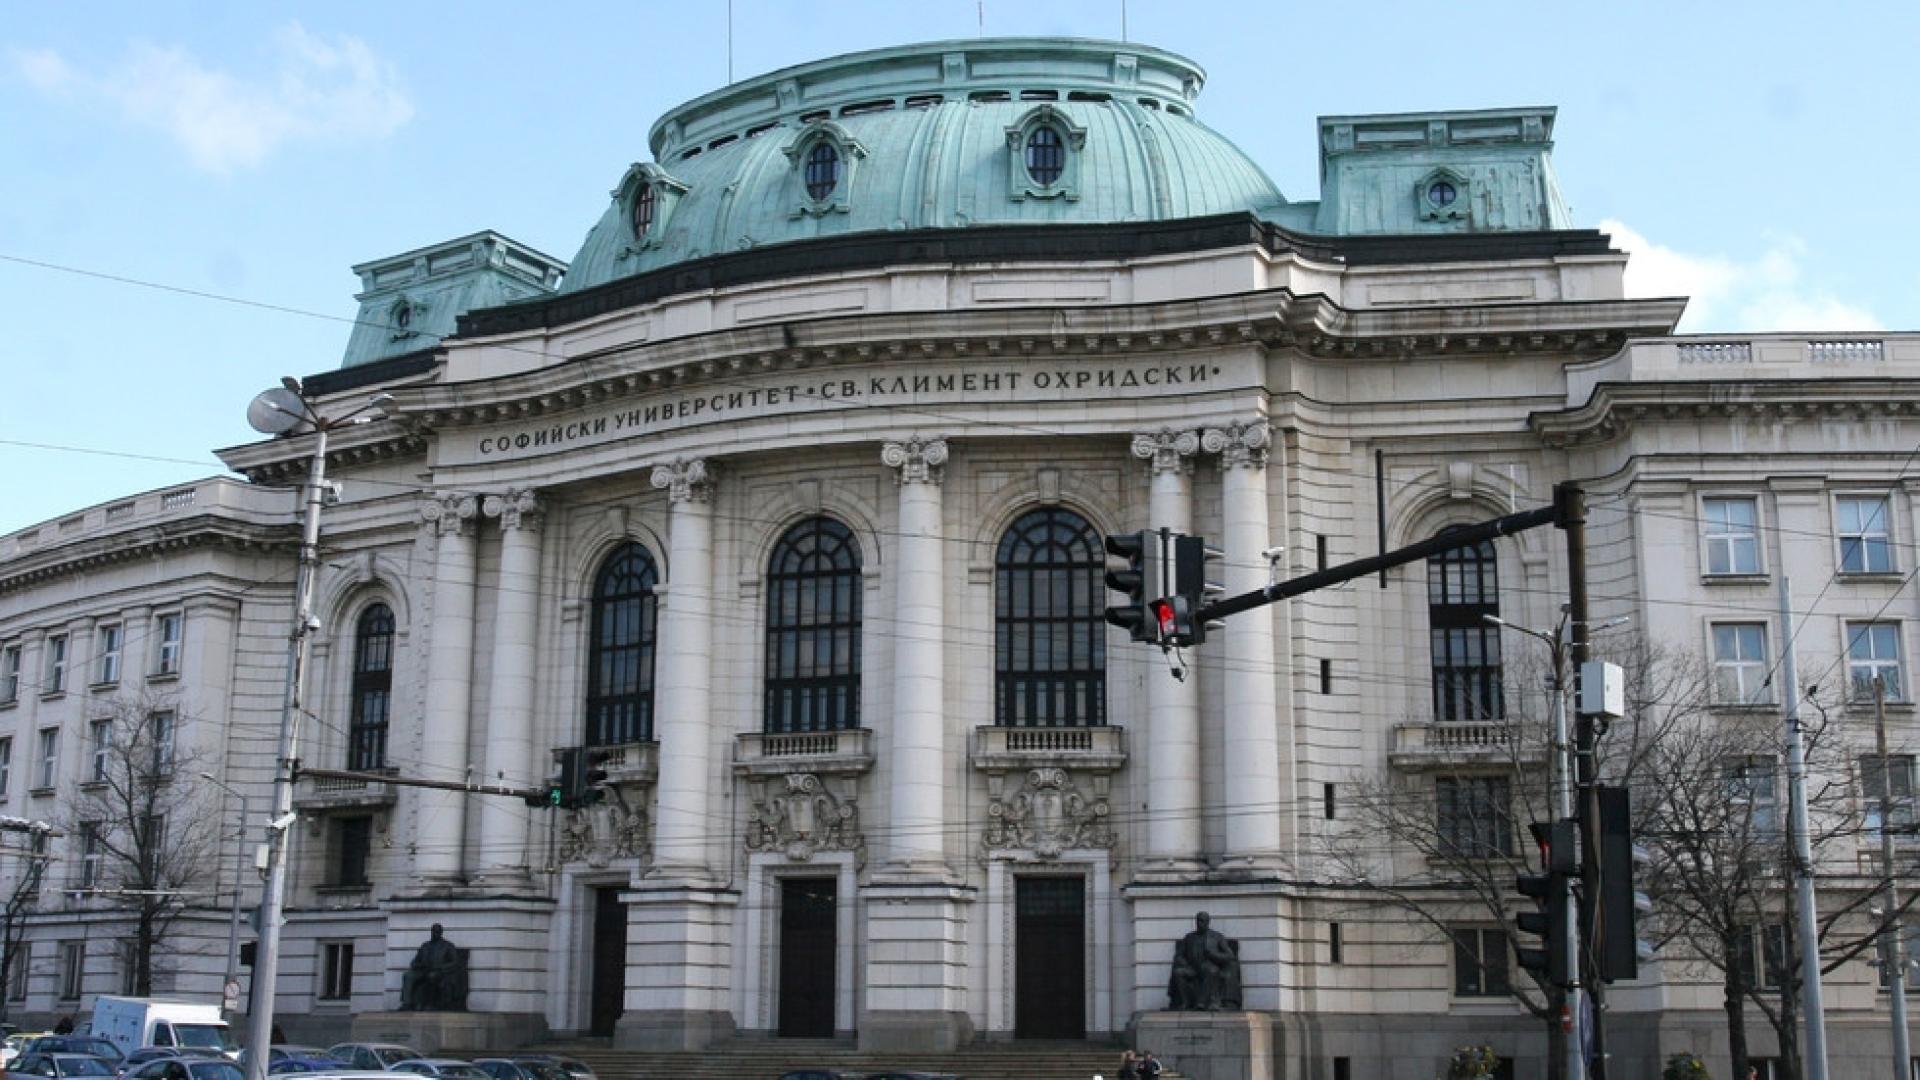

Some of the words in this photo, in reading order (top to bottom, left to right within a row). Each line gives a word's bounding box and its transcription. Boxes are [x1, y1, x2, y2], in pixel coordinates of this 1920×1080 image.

[480, 417, 607, 454] СОФИЙСКИ
[615, 385, 800, 430] УНИВЕРСИТЕТ
[821, 379, 862, 401] СВ.
[870, 371, 1021, 396] КЛИМЕНТ
[1033, 364, 1207, 389] ОХРИДСКИ
